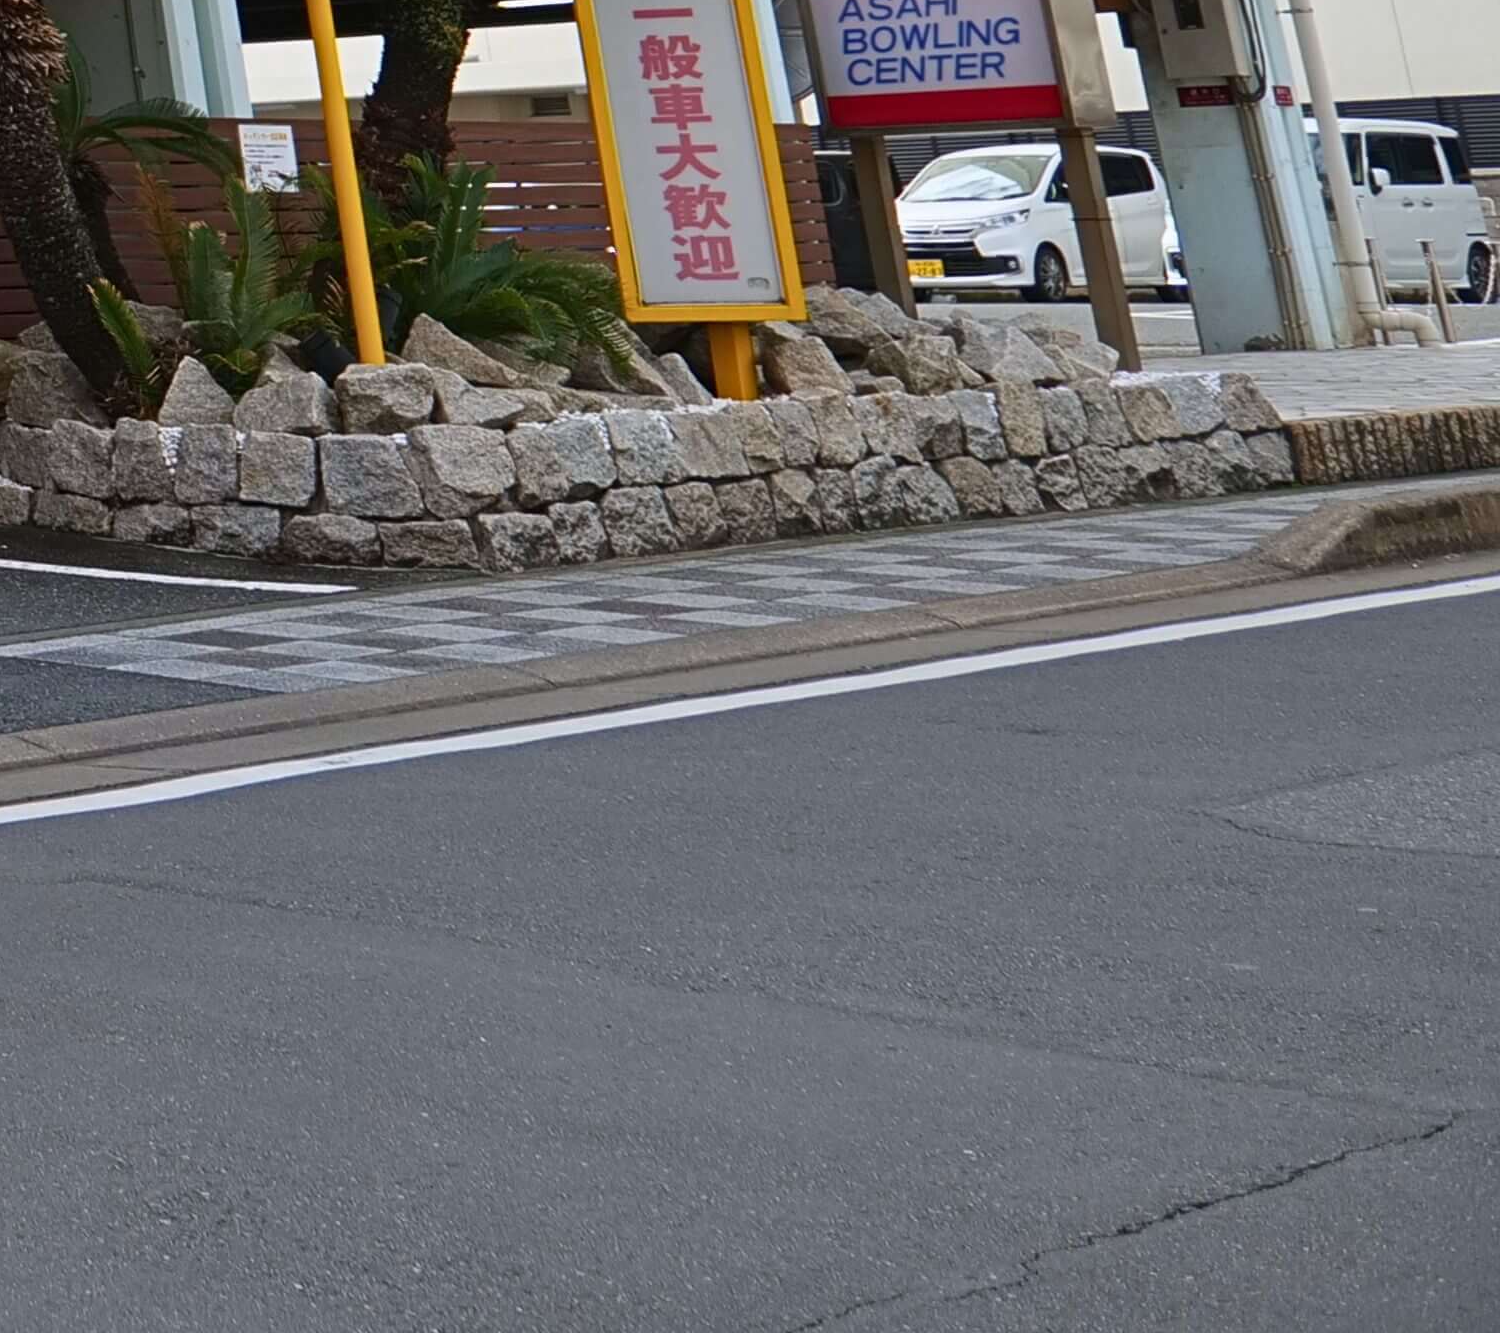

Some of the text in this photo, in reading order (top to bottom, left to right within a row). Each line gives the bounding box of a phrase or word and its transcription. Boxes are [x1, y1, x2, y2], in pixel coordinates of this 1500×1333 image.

[843, 17, 1020, 55] BOWLING
[848, 51, 1005, 87] CENTER
[632, 7, 740, 282] 一般車大歓迎
